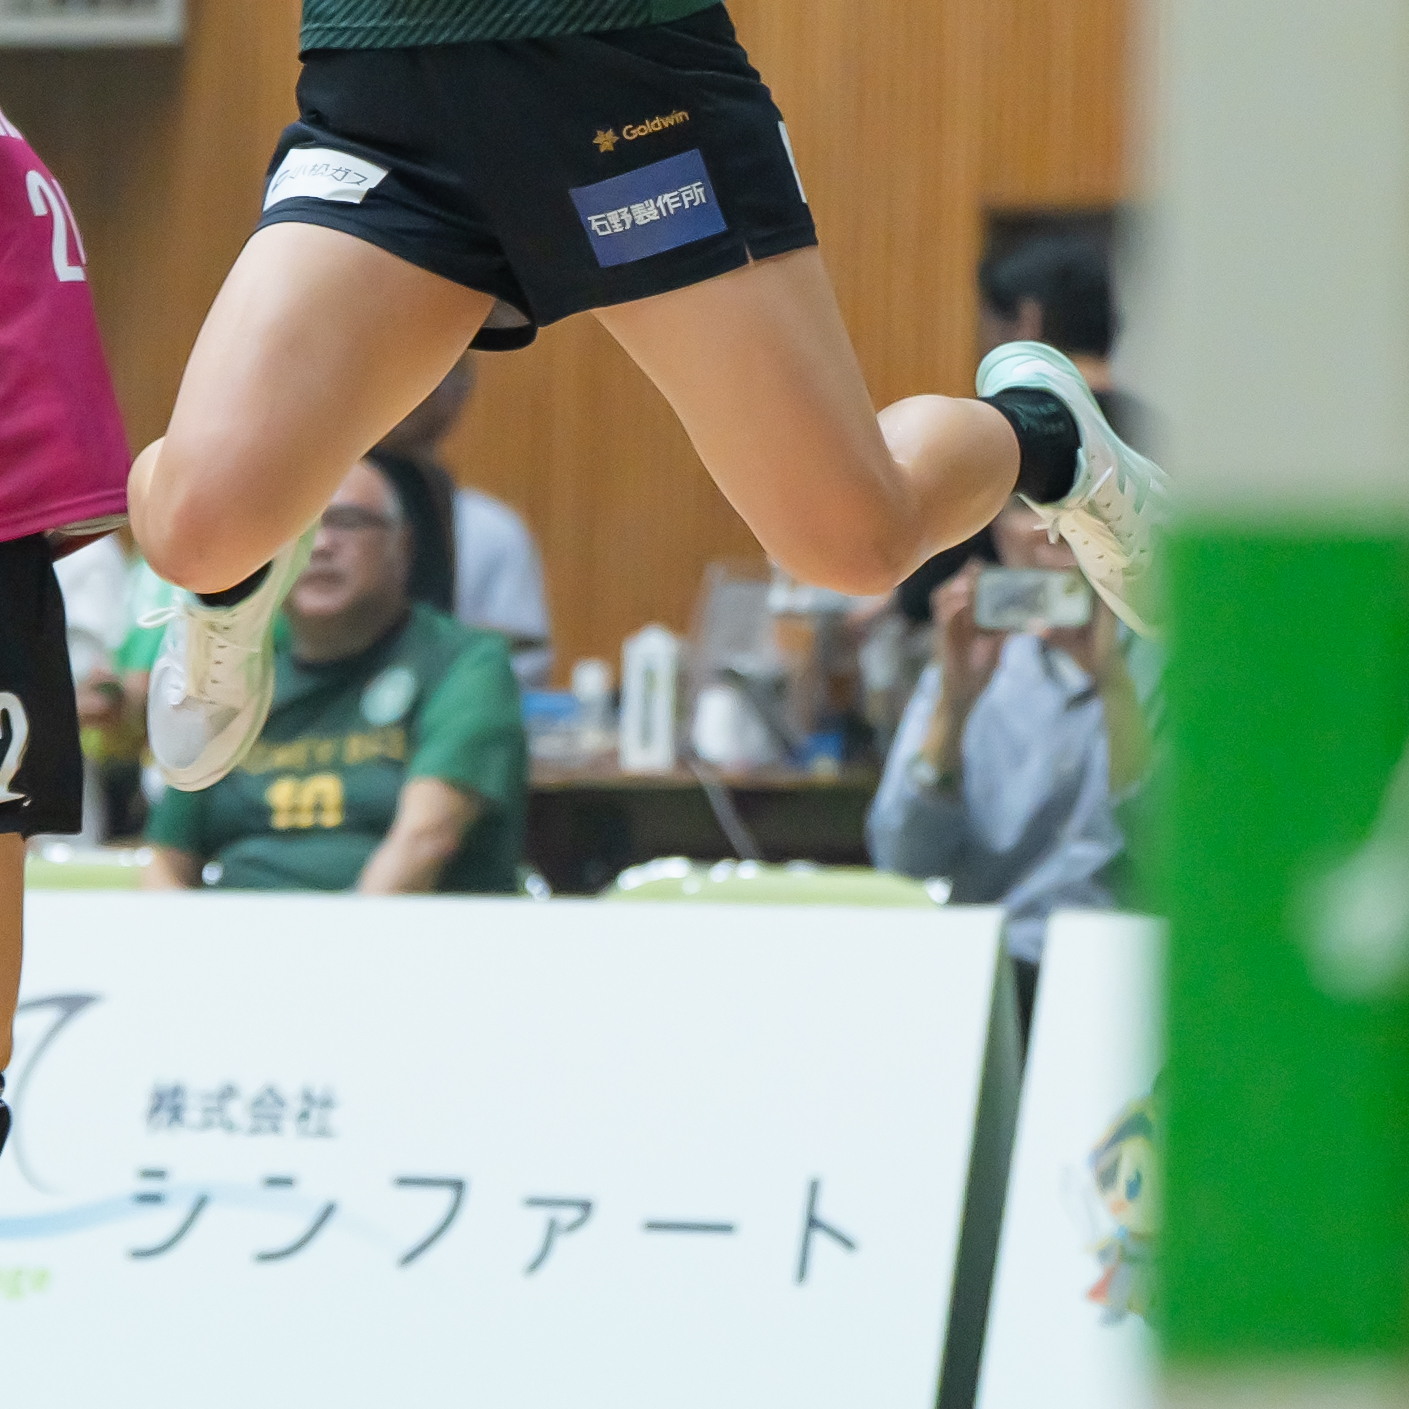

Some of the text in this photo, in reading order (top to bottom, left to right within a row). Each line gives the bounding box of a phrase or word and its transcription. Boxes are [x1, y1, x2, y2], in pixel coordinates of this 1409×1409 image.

[621, 108, 691, 142] Goldwin
[586, 180, 708, 238] 石野製作所
[145, 1081, 339, 1139] 株式会社
[128, 1169, 856, 1285] シンファート
